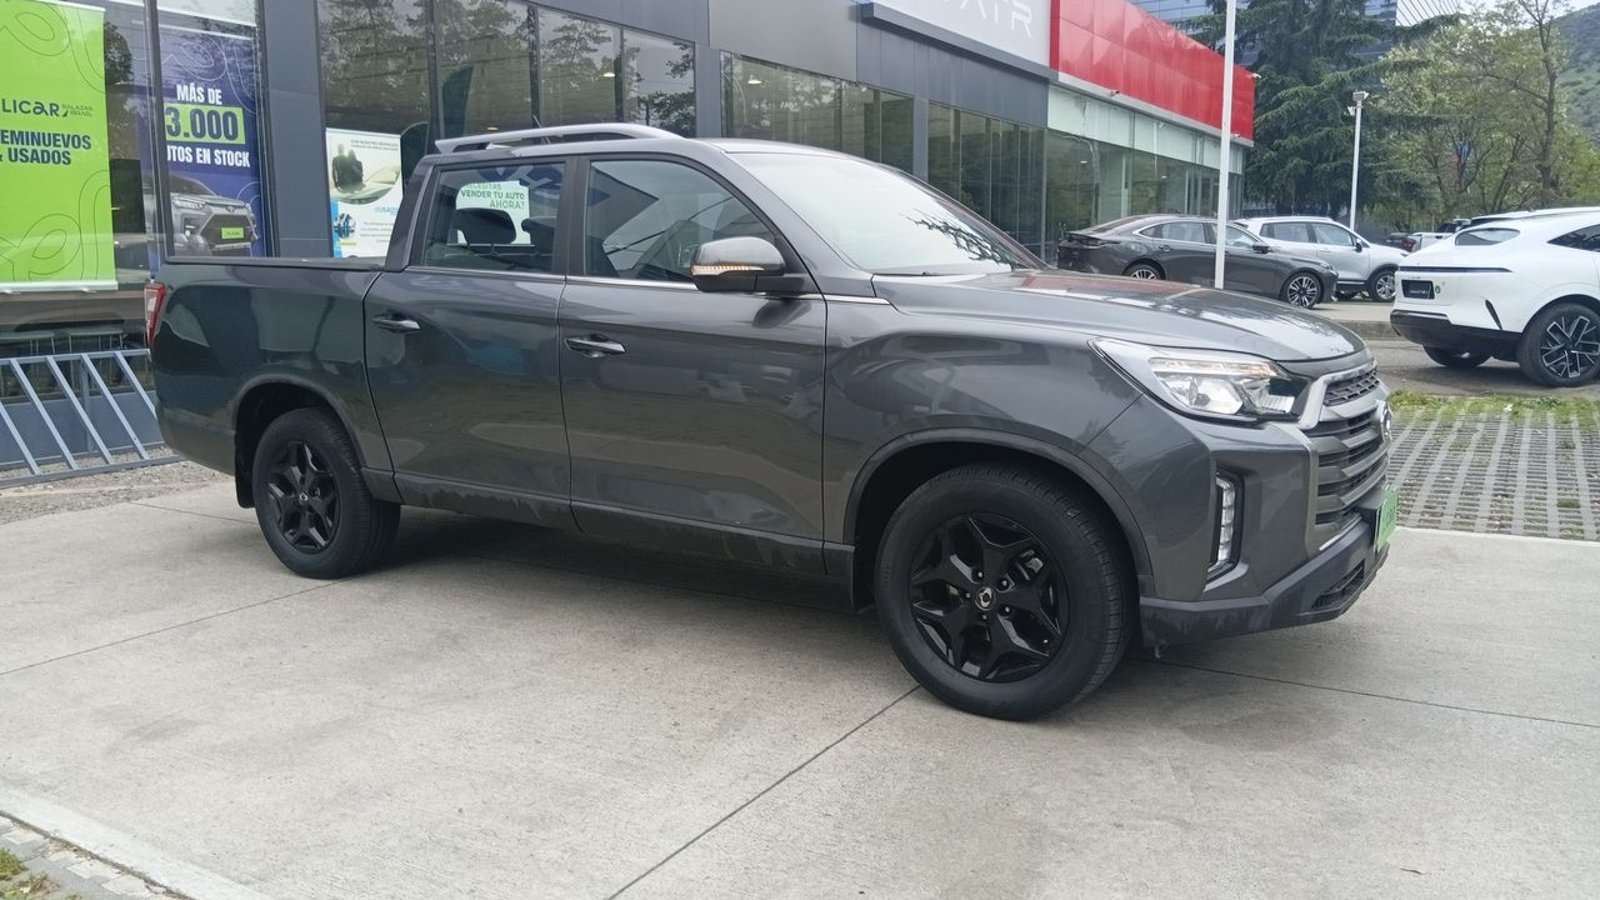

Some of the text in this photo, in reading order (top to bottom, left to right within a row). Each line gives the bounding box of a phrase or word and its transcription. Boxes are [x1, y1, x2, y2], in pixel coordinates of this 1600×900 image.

[176, 82, 222, 106] MÁS DE
[165, 107, 239, 141] 3.000
[0, 129, 92, 150] EMINUEVOS
[7, 147, 72, 166] USADOS
[196, 147, 211, 165] EN
[214, 149, 250, 168] STOCK
[460, 189, 525, 200] VENDER TU AUTO
